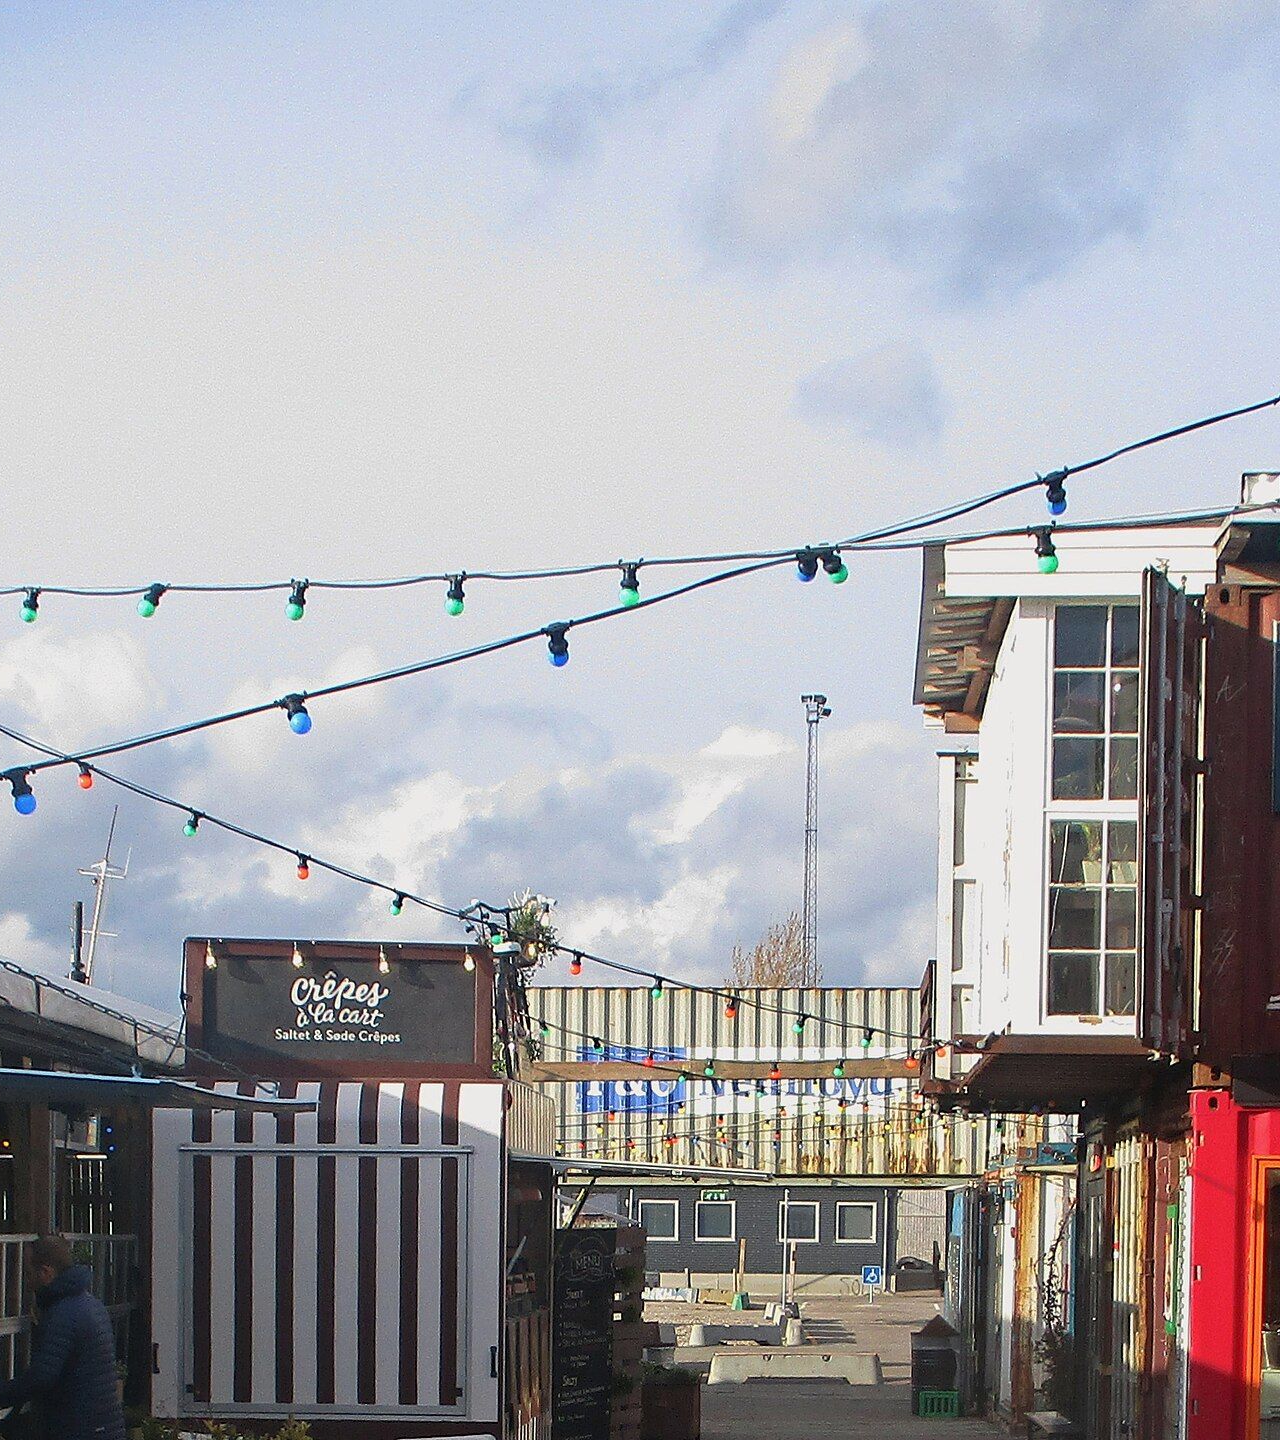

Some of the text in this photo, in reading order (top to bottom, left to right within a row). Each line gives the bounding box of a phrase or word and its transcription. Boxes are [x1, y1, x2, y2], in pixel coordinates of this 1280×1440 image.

[291, 970, 389, 1009] Crêpes
[308, 1003, 336, 1024] la
[338, 1008, 384, 1028] cart
[274, 1029, 401, 1045] Saltet & Søde Crêpes
